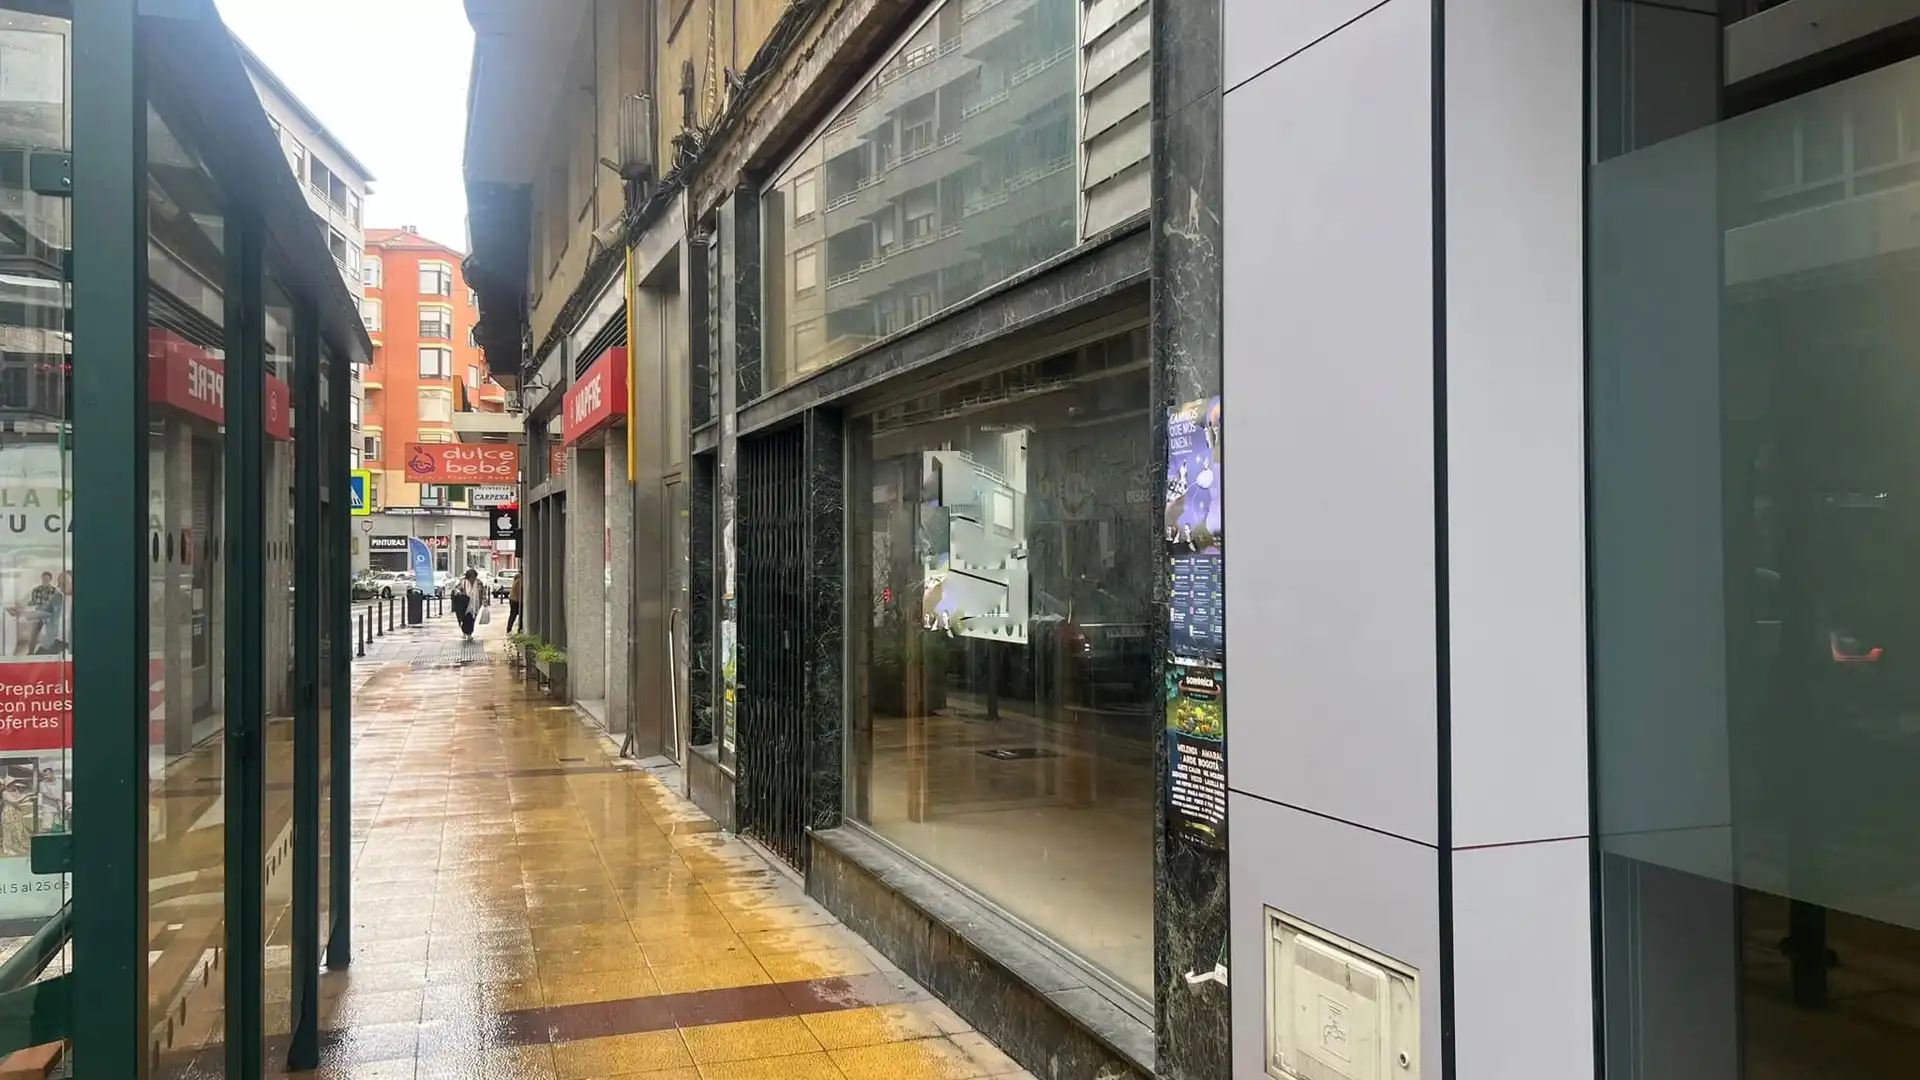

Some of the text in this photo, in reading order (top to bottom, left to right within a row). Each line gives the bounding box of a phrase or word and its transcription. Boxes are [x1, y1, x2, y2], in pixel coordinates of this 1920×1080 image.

[575, 372, 601, 424] MAPFRE
[442, 447, 514, 460] dulce
[446, 460, 511, 475] bebé
[0, 679, 73, 699] Prepáral
[31, 699, 73, 712] nues
[1182, 754, 1197, 766] ARDE
[1201, 749, 1224, 762] AMARAL
[10, 883, 18, 893] 5
[21, 880, 32, 893] al
[35, 881, 51, 892] 25
